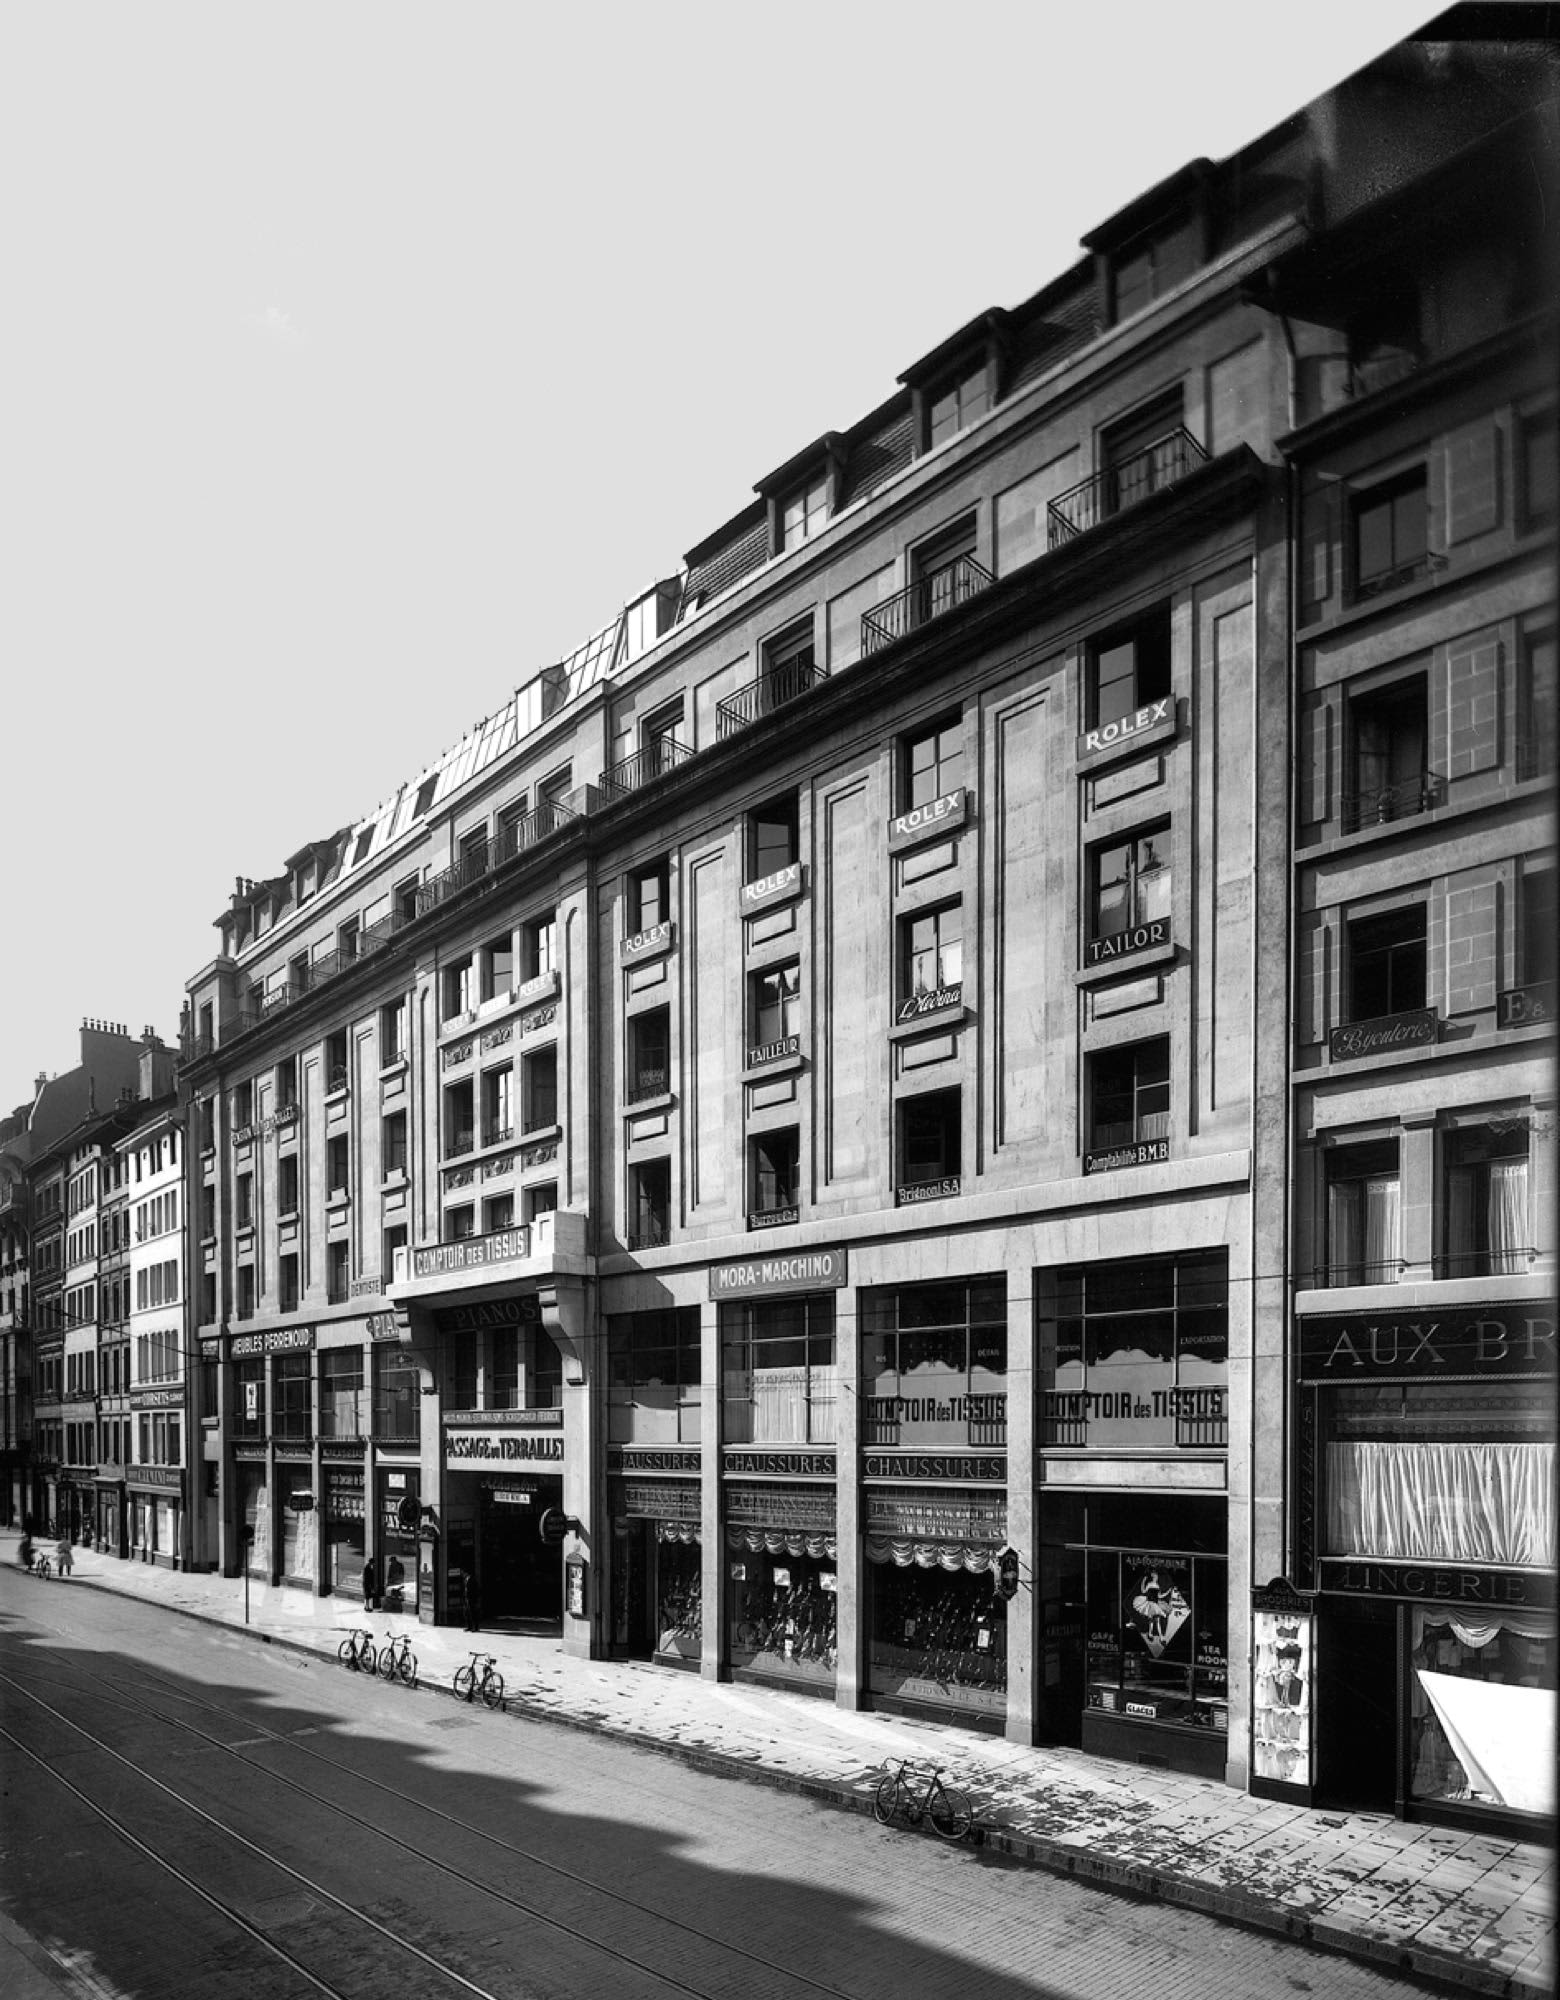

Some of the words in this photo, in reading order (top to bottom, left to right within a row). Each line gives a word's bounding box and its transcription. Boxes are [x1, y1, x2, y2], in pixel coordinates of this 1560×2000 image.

[1087, 699, 1167, 750] ROLEX
[896, 791, 959, 833] ROLEX
[746, 866, 796, 899] ROLEX
[626, 924, 667, 952] ROLEX
[1090, 924, 1165, 960] TAILOR
[750, 1038, 798, 1065] TAILLEUR
[416, 1244, 464, 1275] COMPTOIR
[466, 1246, 484, 1265] DES
[485, 1231, 525, 1261] TISSUS
[719, 1254, 832, 1288] MORA-MARCHINO
[351, 1279, 381, 1297] DENTISTE
[455, 1301, 537, 1328] PIANOS
[264, 1328, 309, 1350] PERRENOUD
[1323, 1323, 1446, 1367] AUX
[937, 1401, 950, 1422] des
[950, 1397, 1004, 1422] TISSUS
[1133, 1395, 1152, 1419] des
[1152, 1390, 1222, 1418] TISSUS
[446, 1437, 491, 1459] PASSAGE
[724, 1454, 832, 1473] CHAUSSURES
[865, 1457, 1001, 1479] CHAUSSURES
[1343, 1566, 1526, 1601] LINGERIE
[1197, 1655, 1227, 1666] ROOM
[1203, 1645, 1221, 1655] TEA
[1127, 1703, 1154, 1717] GLACES
